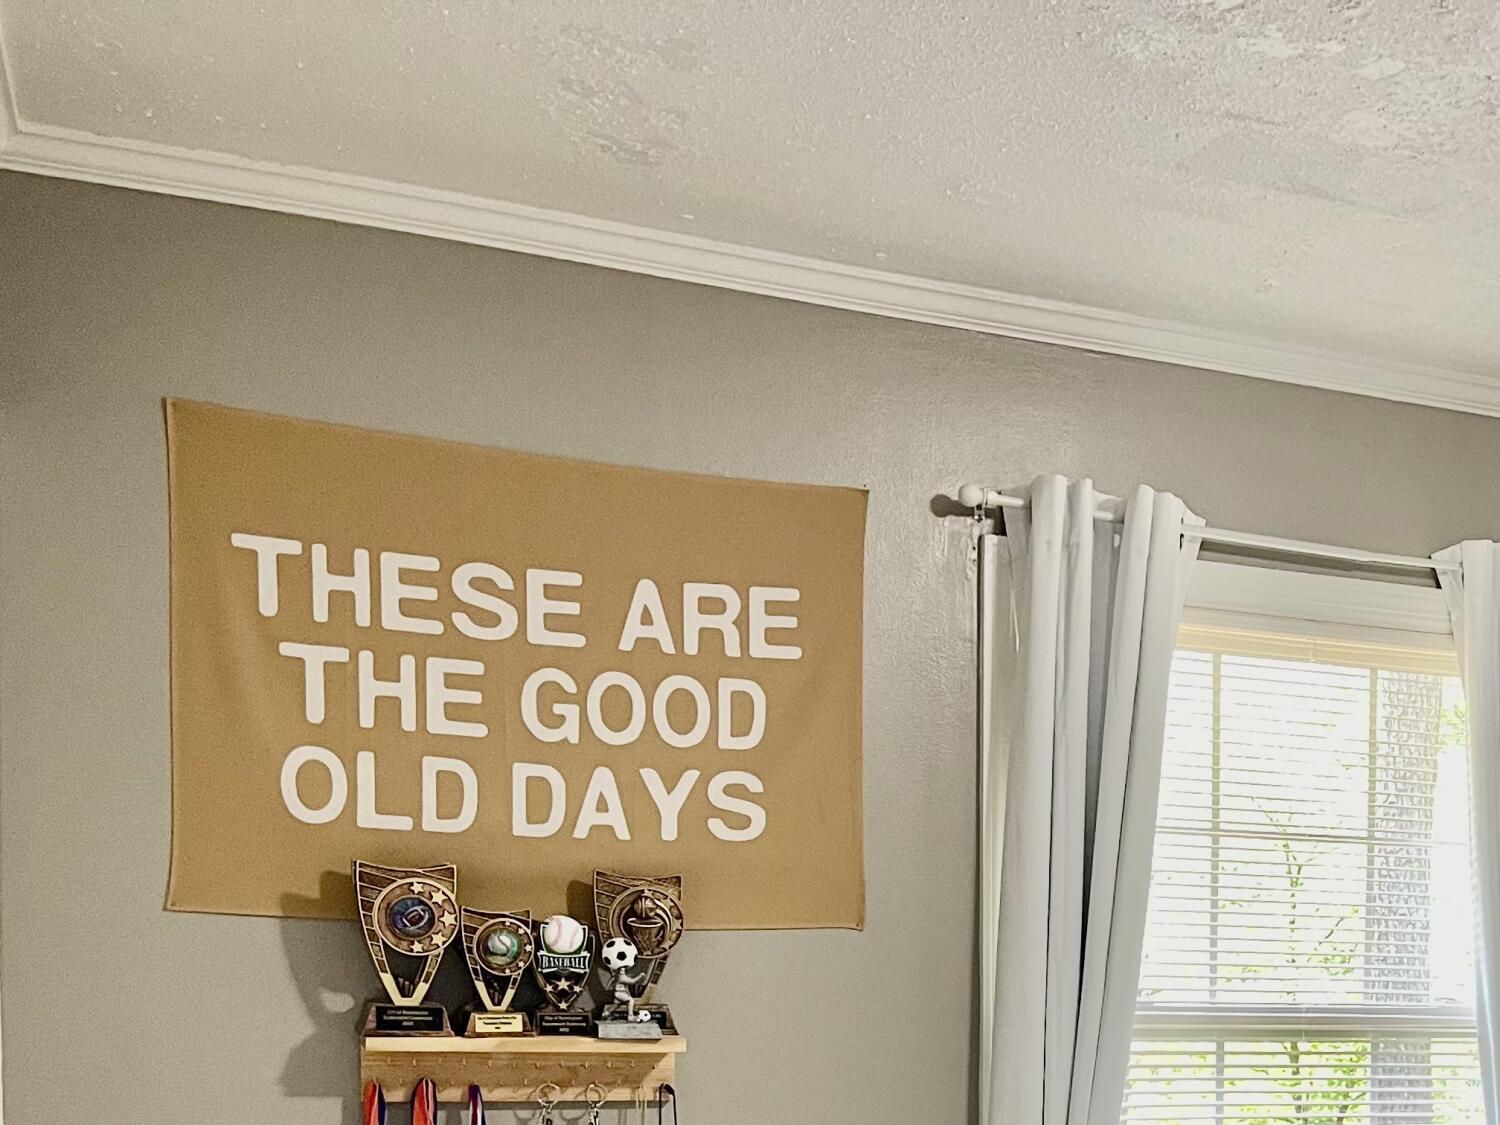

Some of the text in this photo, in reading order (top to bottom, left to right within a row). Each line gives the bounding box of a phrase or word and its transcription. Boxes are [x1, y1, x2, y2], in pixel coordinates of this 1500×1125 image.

[230, 533, 803, 660] THESE ARE
[278, 642, 767, 750] THE GOOD
[280, 745, 768, 843] OLD DAYS
[542, 955, 585, 969] BASEBALL
